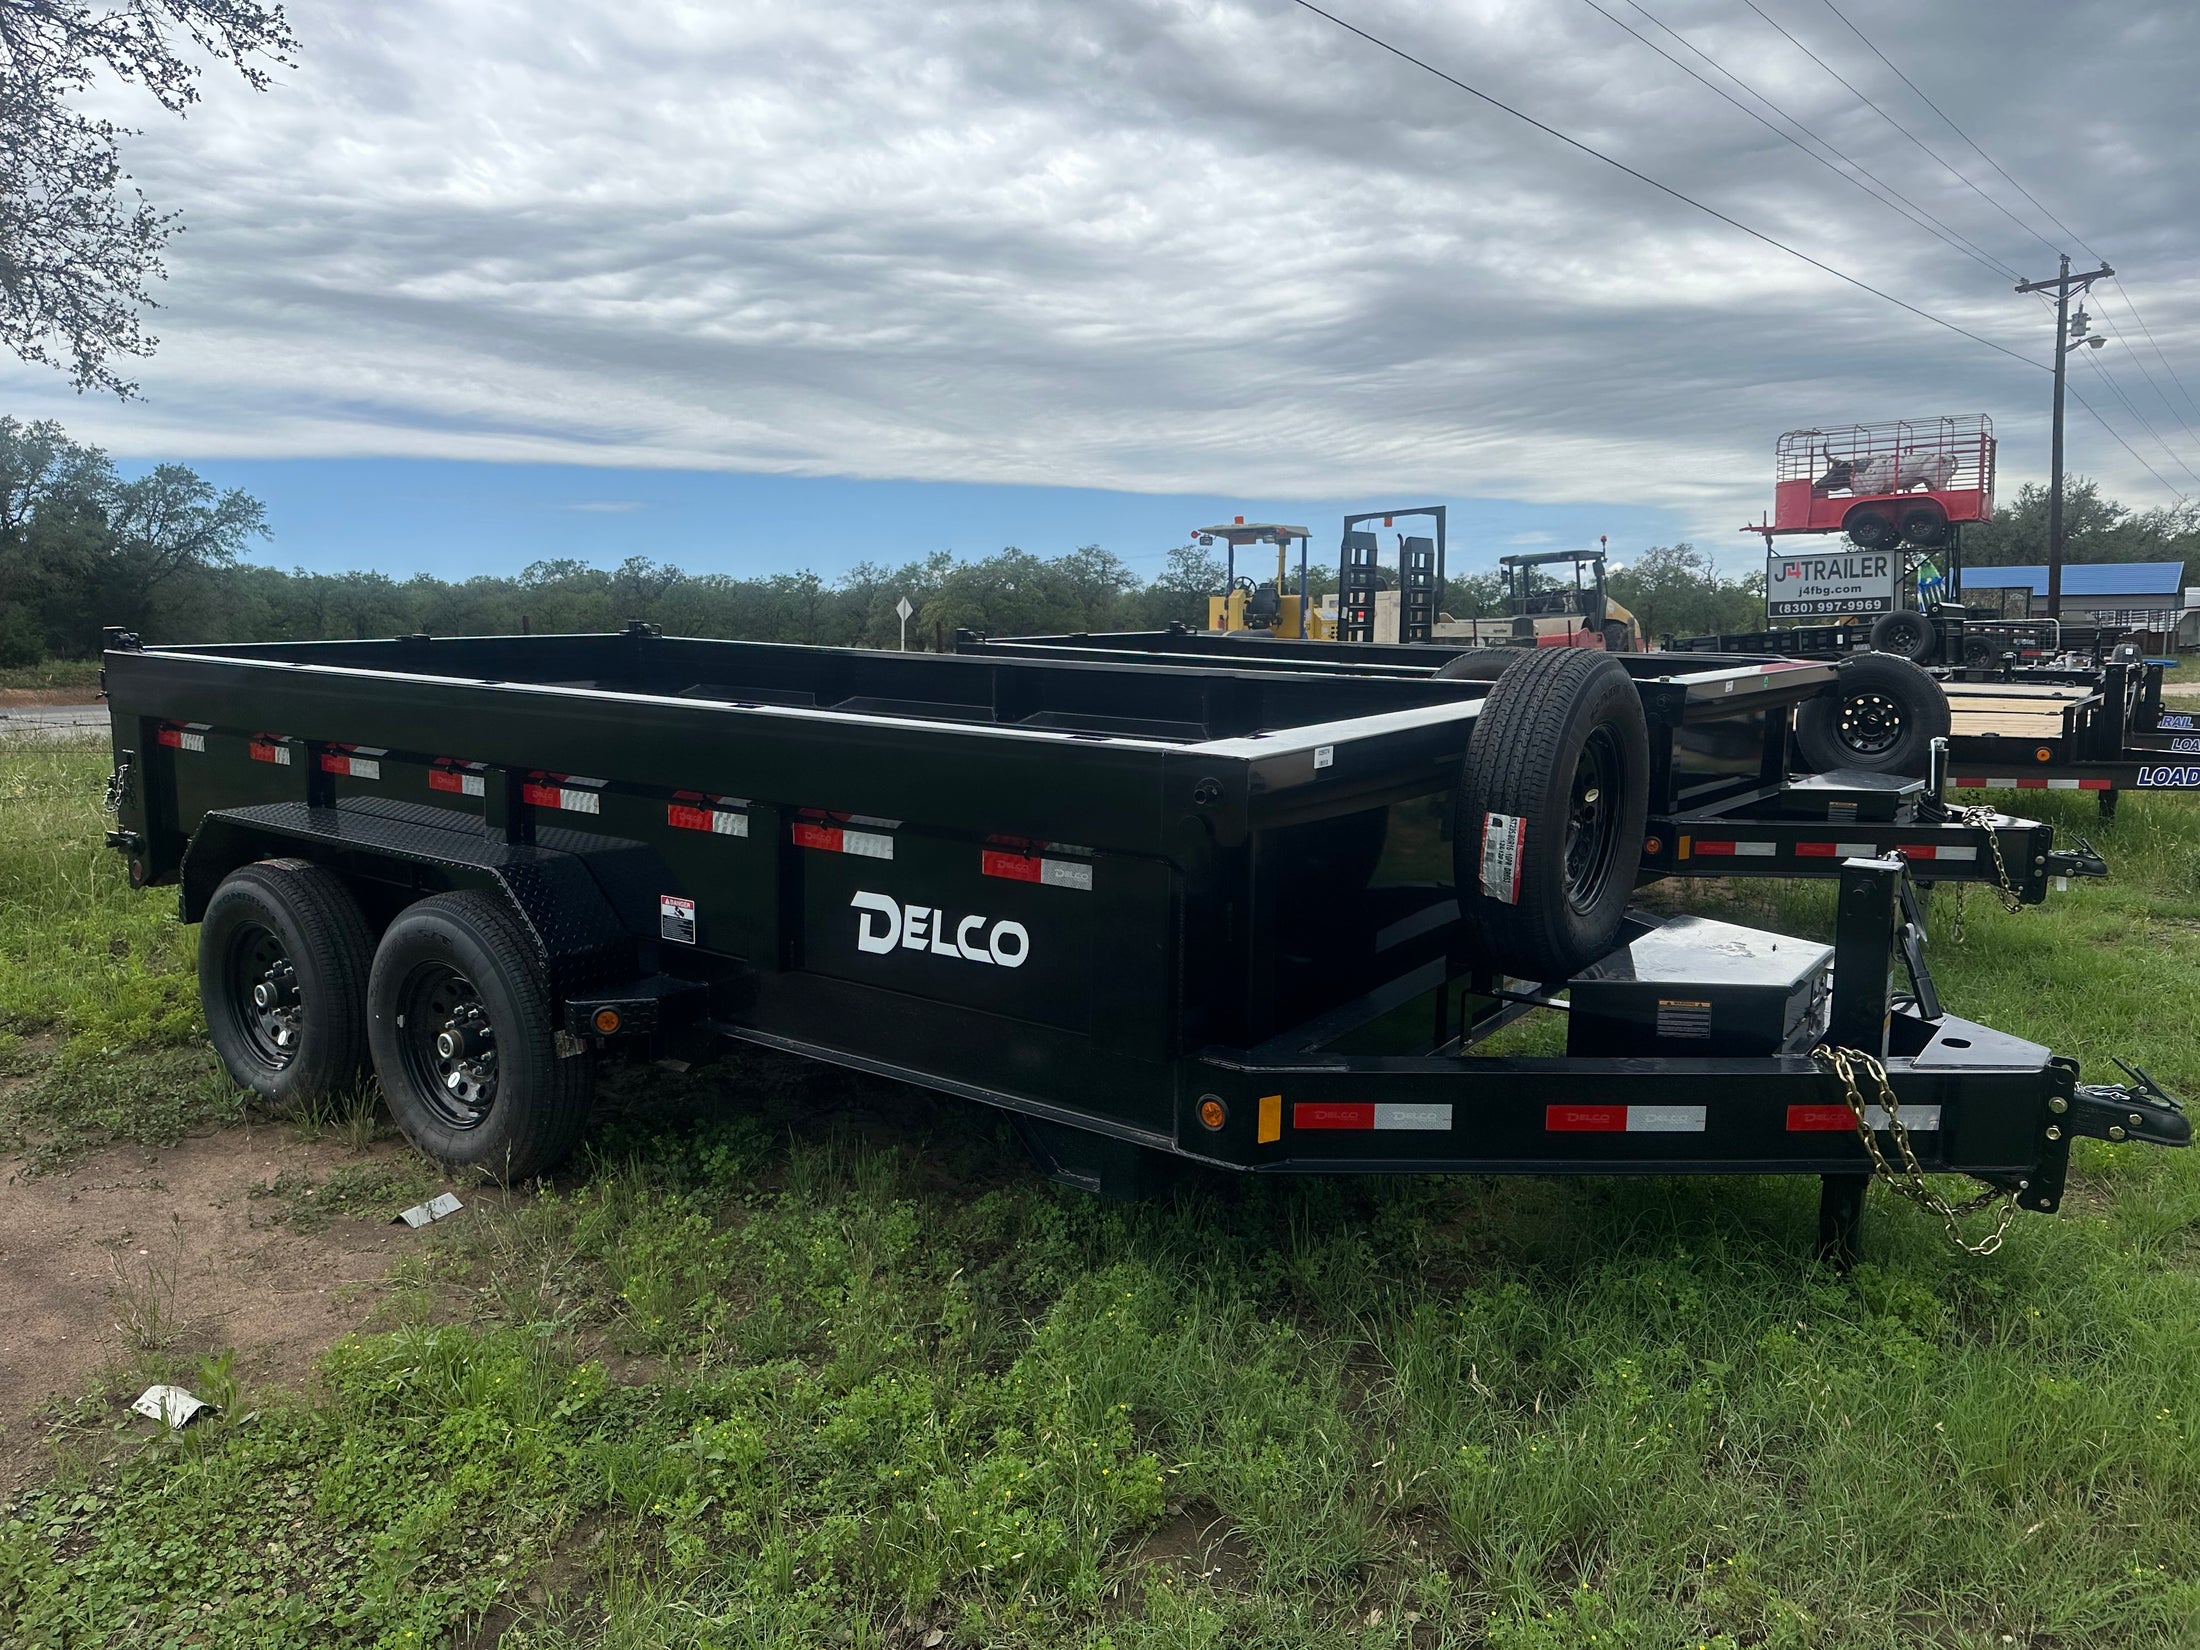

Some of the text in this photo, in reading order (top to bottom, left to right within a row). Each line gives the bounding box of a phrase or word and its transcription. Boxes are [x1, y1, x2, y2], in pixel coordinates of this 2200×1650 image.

[1798, 585, 1862, 597] j4fbg.com
[1779, 600, 1882, 614] (830) 997-9969
[2158, 715, 2194, 728] RAIL
[1054, 868, 1089, 880] DELCO
[850, 890, 1030, 968] DELCO
[1314, 1110, 1437, 1121] DELCO DELCO
[1567, 1112, 1610, 1122] DELCO
